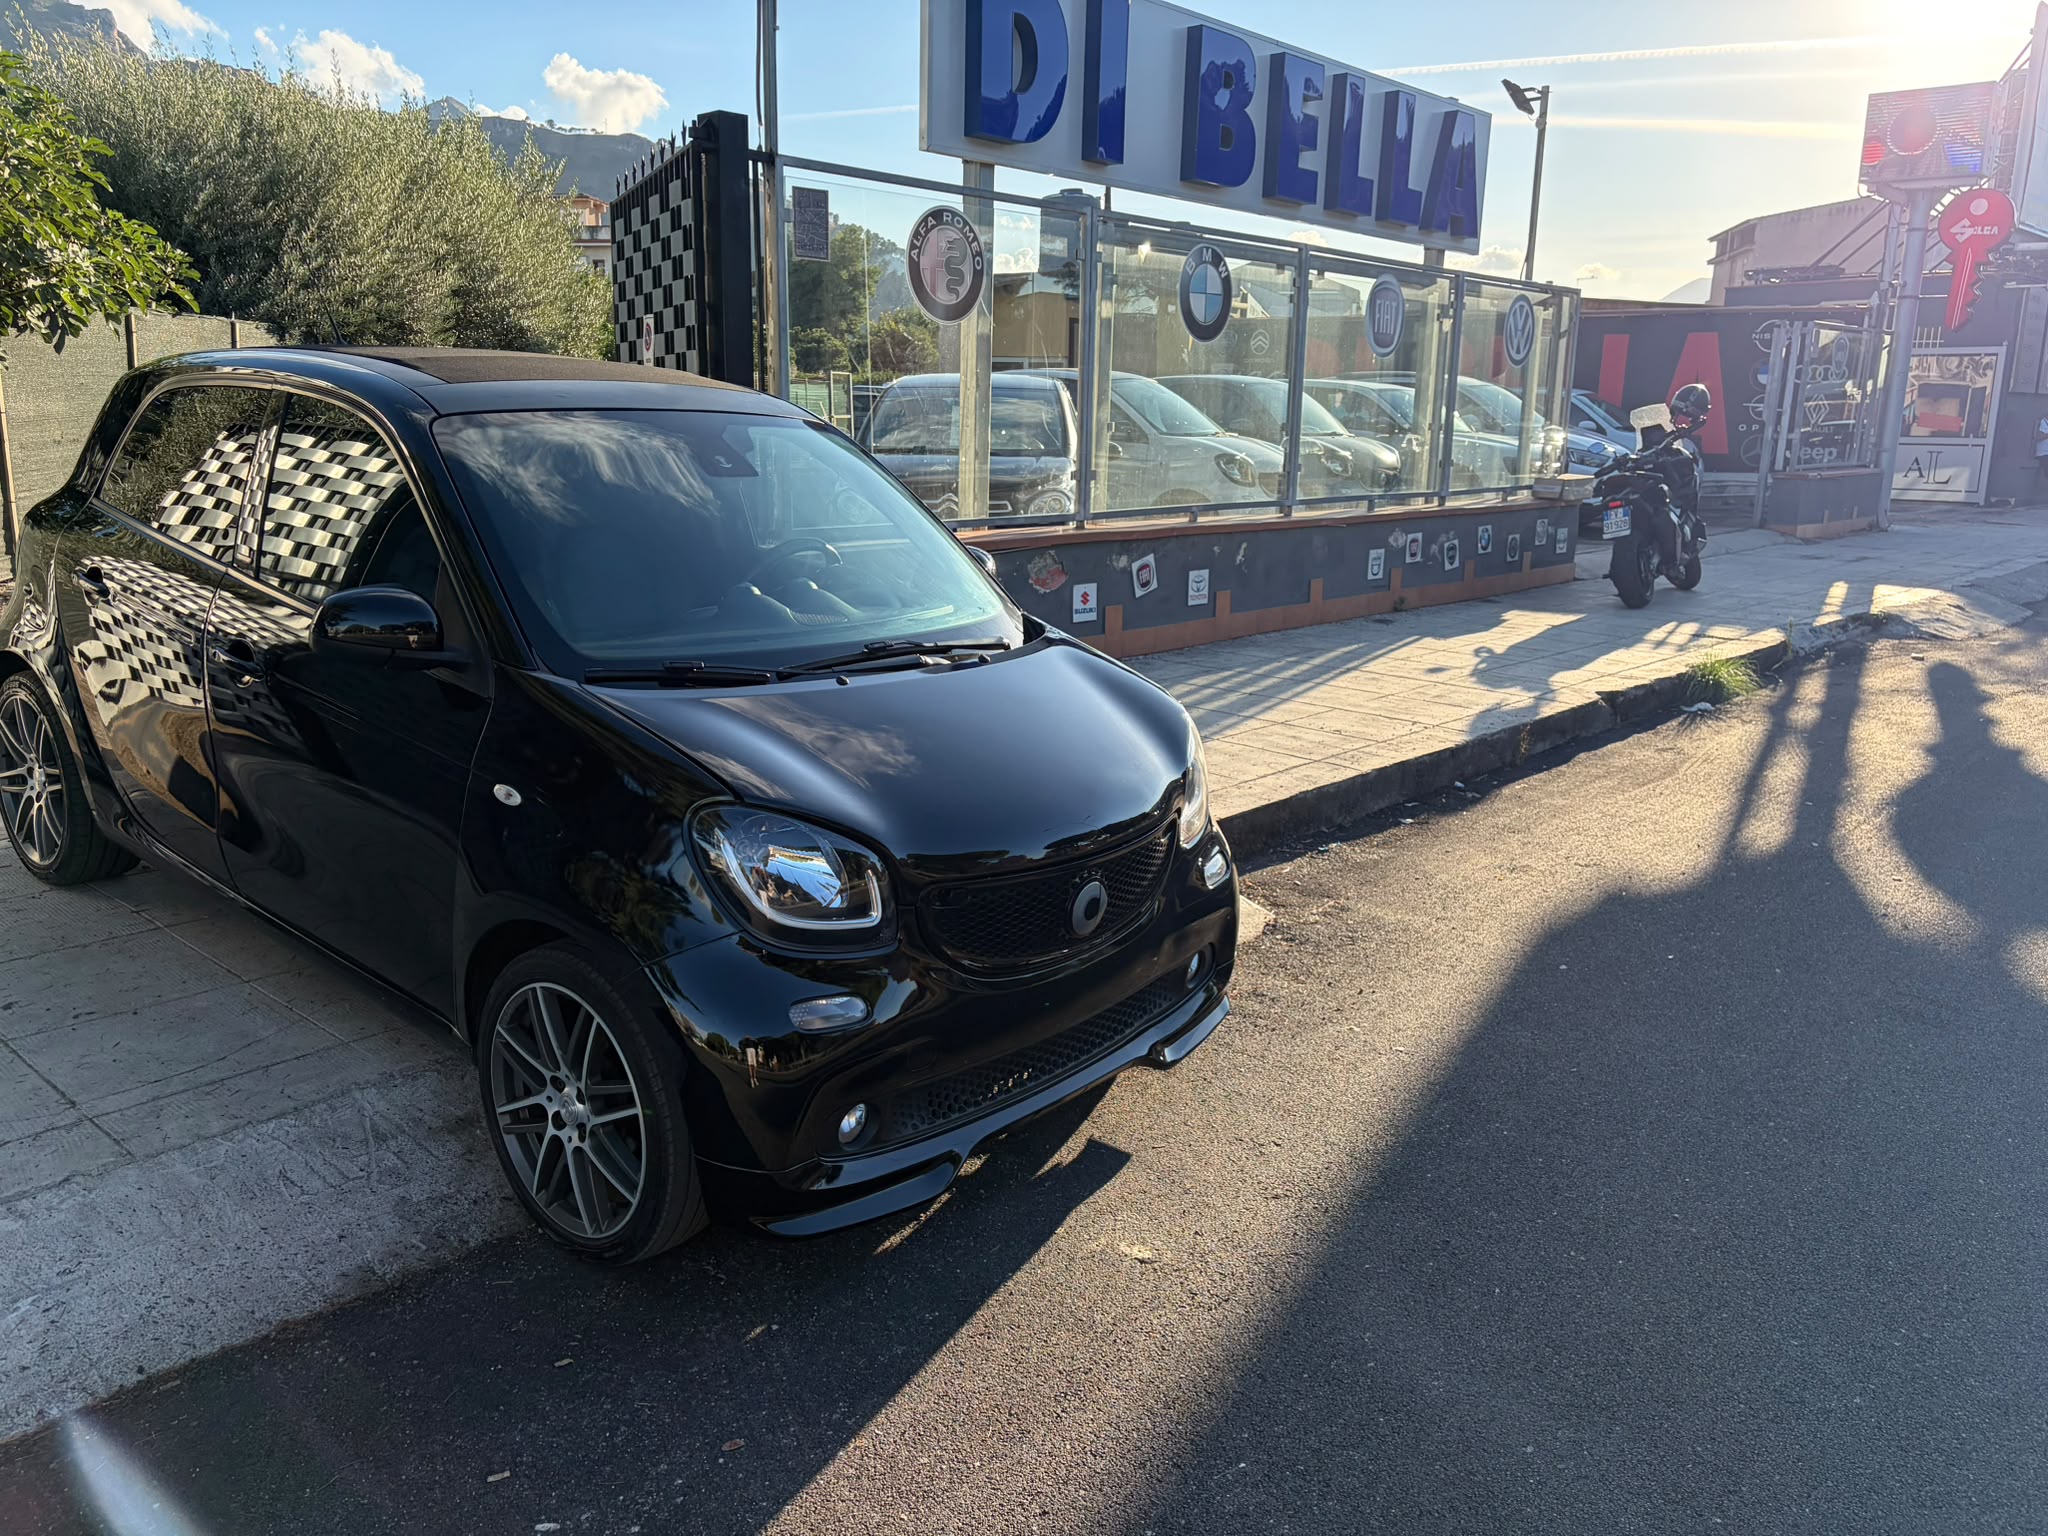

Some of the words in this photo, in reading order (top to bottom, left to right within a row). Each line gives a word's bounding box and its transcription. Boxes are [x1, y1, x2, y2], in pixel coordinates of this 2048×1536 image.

[965, 0, 1130, 164] DI
[1181, 24, 1478, 239] BELLA
[910, 216, 937, 262] ALFA
[943, 211, 983, 271] ROMEO
[1185, 247, 1229, 279] BMW
[1374, 301, 1397, 335] FIAT
[1138, 568, 1151, 584] FIAT
